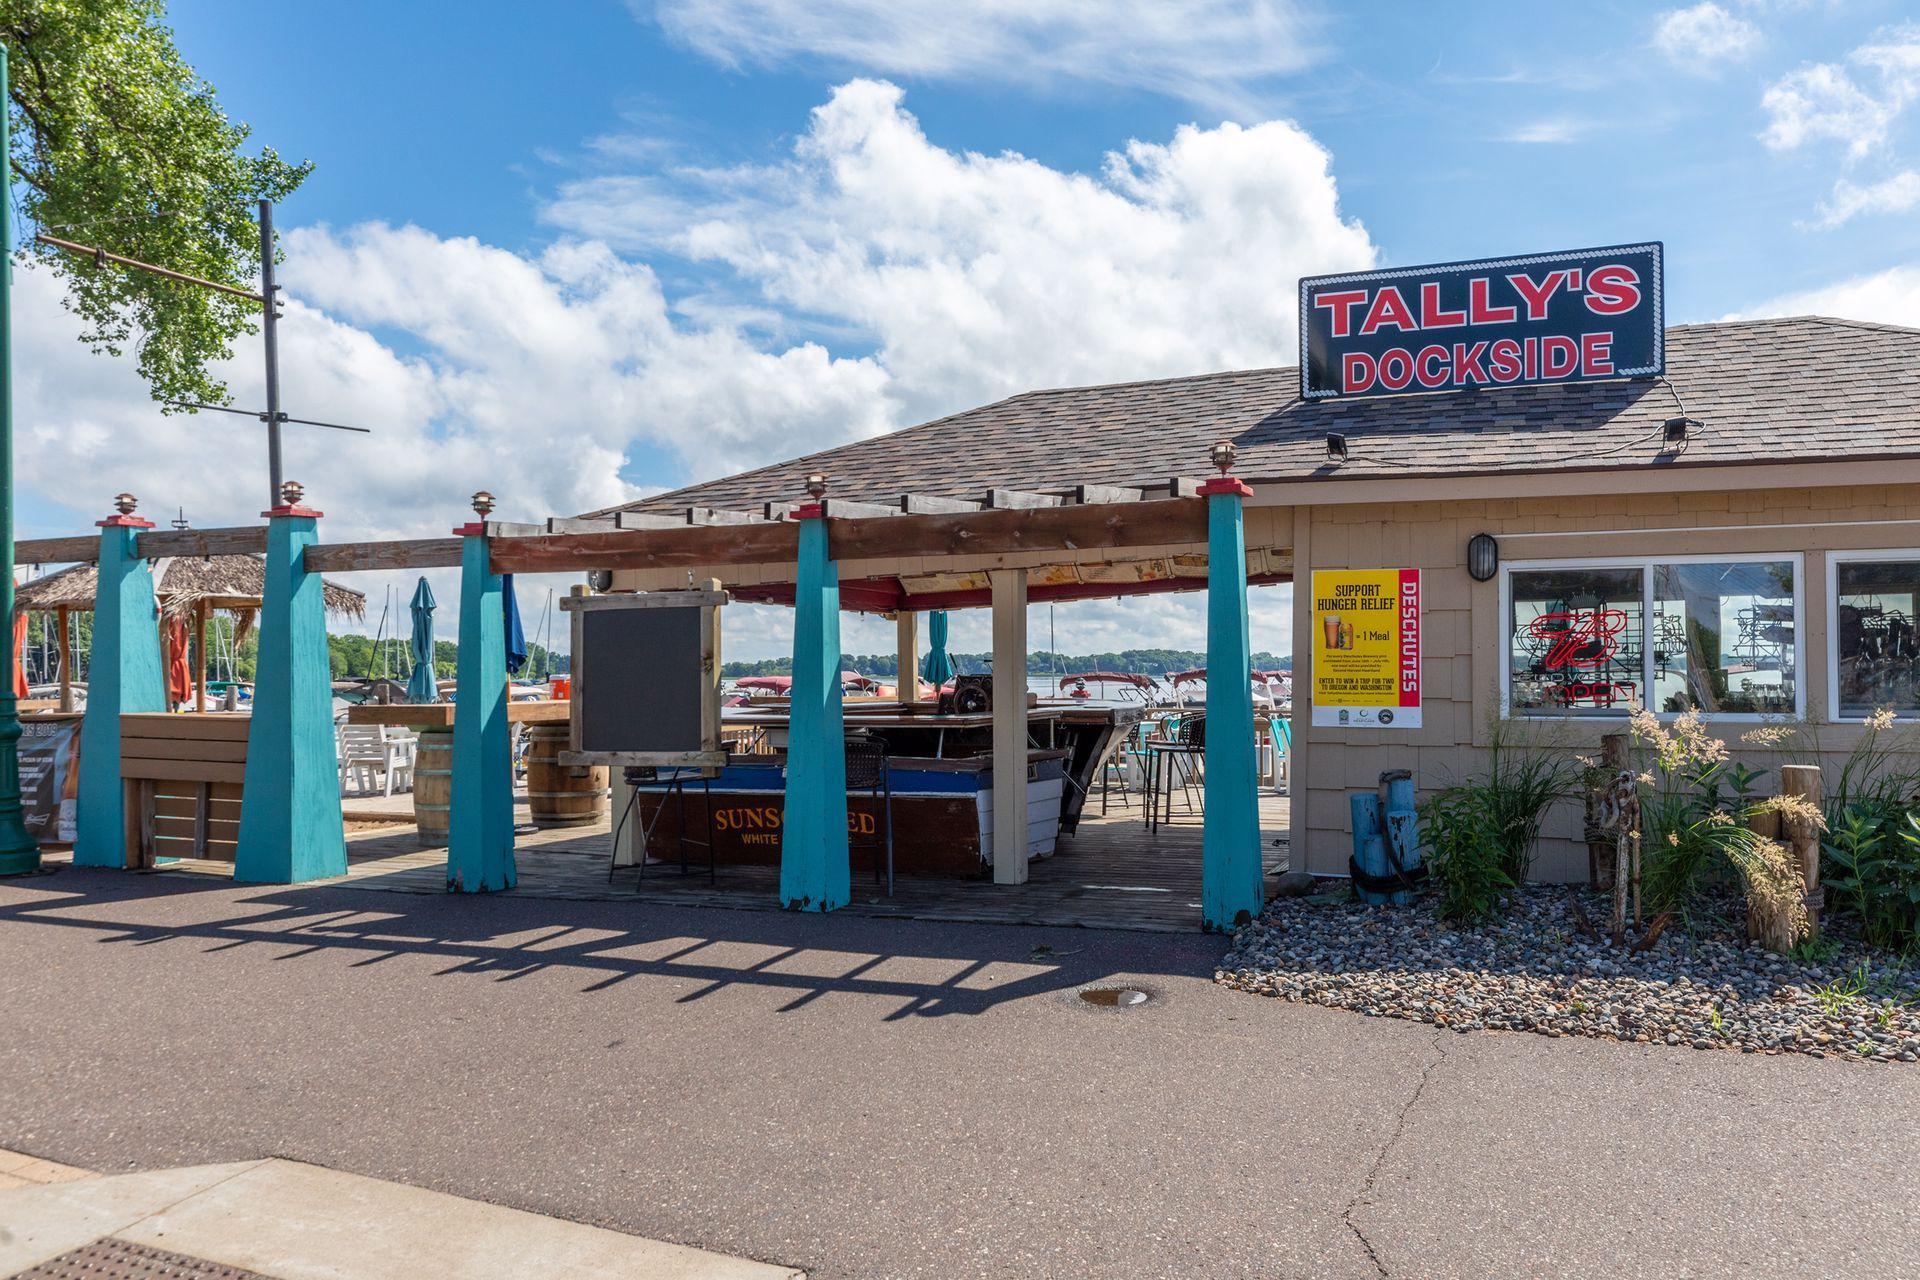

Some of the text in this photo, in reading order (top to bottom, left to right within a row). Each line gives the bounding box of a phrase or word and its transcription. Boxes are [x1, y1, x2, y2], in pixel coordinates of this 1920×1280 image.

[1314, 264, 1641, 338] TALLY'S
[1342, 331, 1614, 394] DOCKSIDE
[1335, 584, 1381, 597] SUPPORT
[1317, 598, 1396, 611] HUNGER RELIEF
[1369, 630, 1390, 641] Meal
[1402, 582, 1417, 692] DESCHUTES
[1545, 682, 1637, 705] OPEN
[741, 833, 778, 845] WHITE
